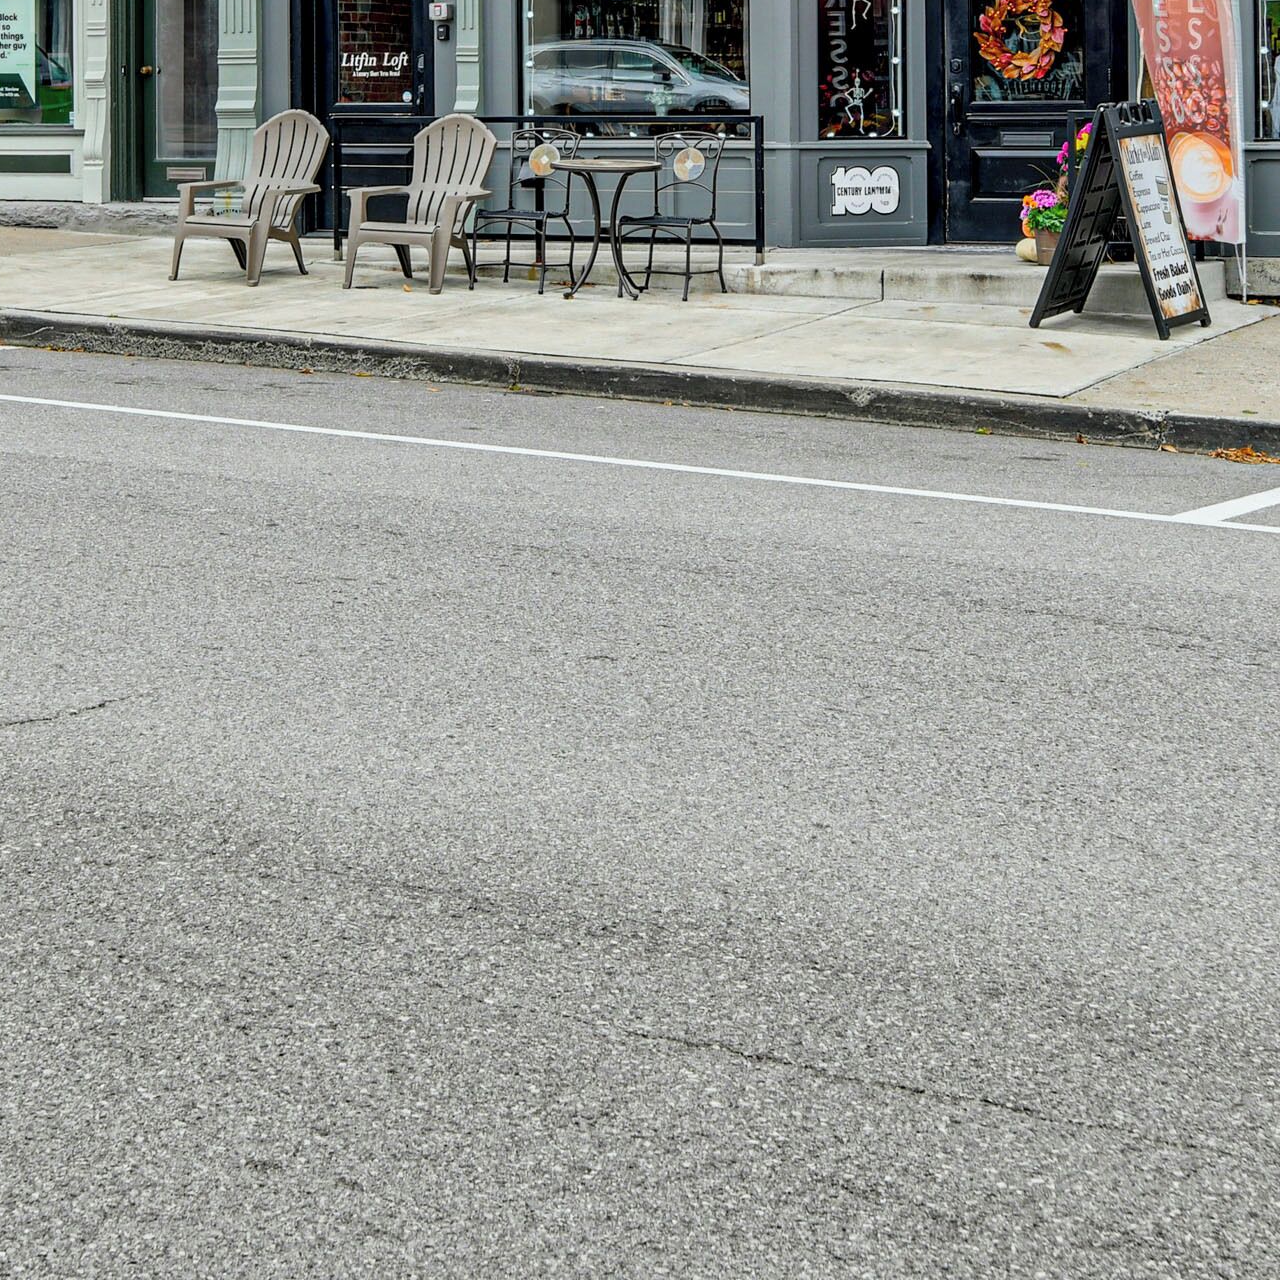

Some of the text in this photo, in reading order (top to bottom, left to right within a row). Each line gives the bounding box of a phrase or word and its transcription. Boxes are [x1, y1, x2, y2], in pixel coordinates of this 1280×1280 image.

[0, 32, 24, 41] things
[12, 42, 27, 51] guy
[341, 51, 409, 71] Litfin Loft
[1128, 170, 1144, 181] Coffee
[836, 186, 862, 196] CENTURY
[1132, 186, 1151, 198] Espresso
[1136, 202, 1161, 215] Cappuccino
[1152, 260, 1189, 282] Fresh Baked
[1158, 285, 1177, 301] Goods
